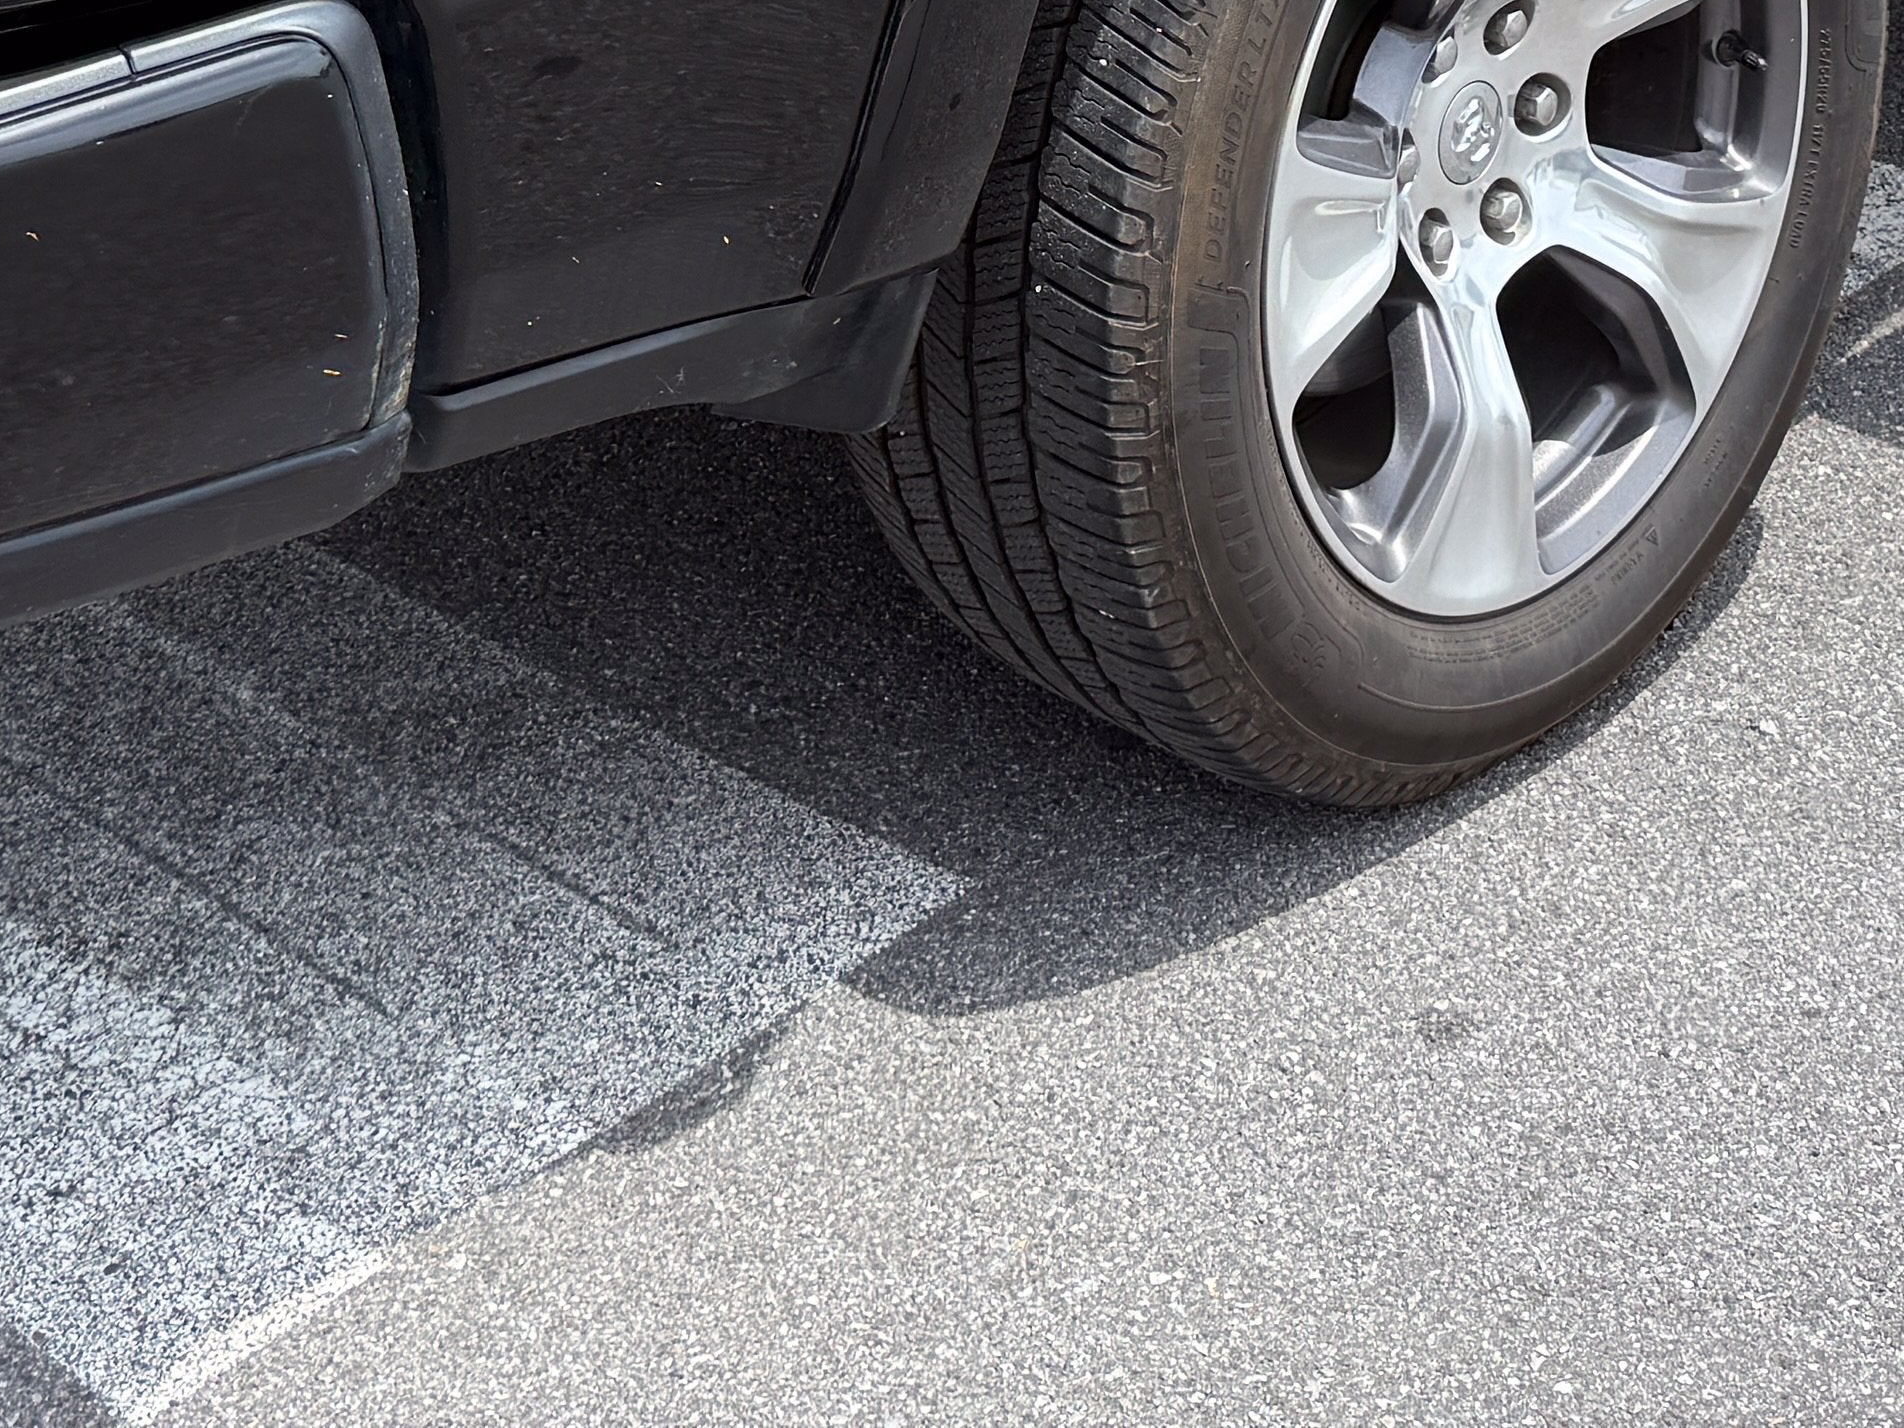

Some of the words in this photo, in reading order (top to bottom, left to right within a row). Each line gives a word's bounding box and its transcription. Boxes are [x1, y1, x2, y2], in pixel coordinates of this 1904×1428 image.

[1203, 59, 1260, 264] DEFENDER
[1789, 211, 1809, 250] LOAD
[1198, 346, 1299, 642] MICHELIN
